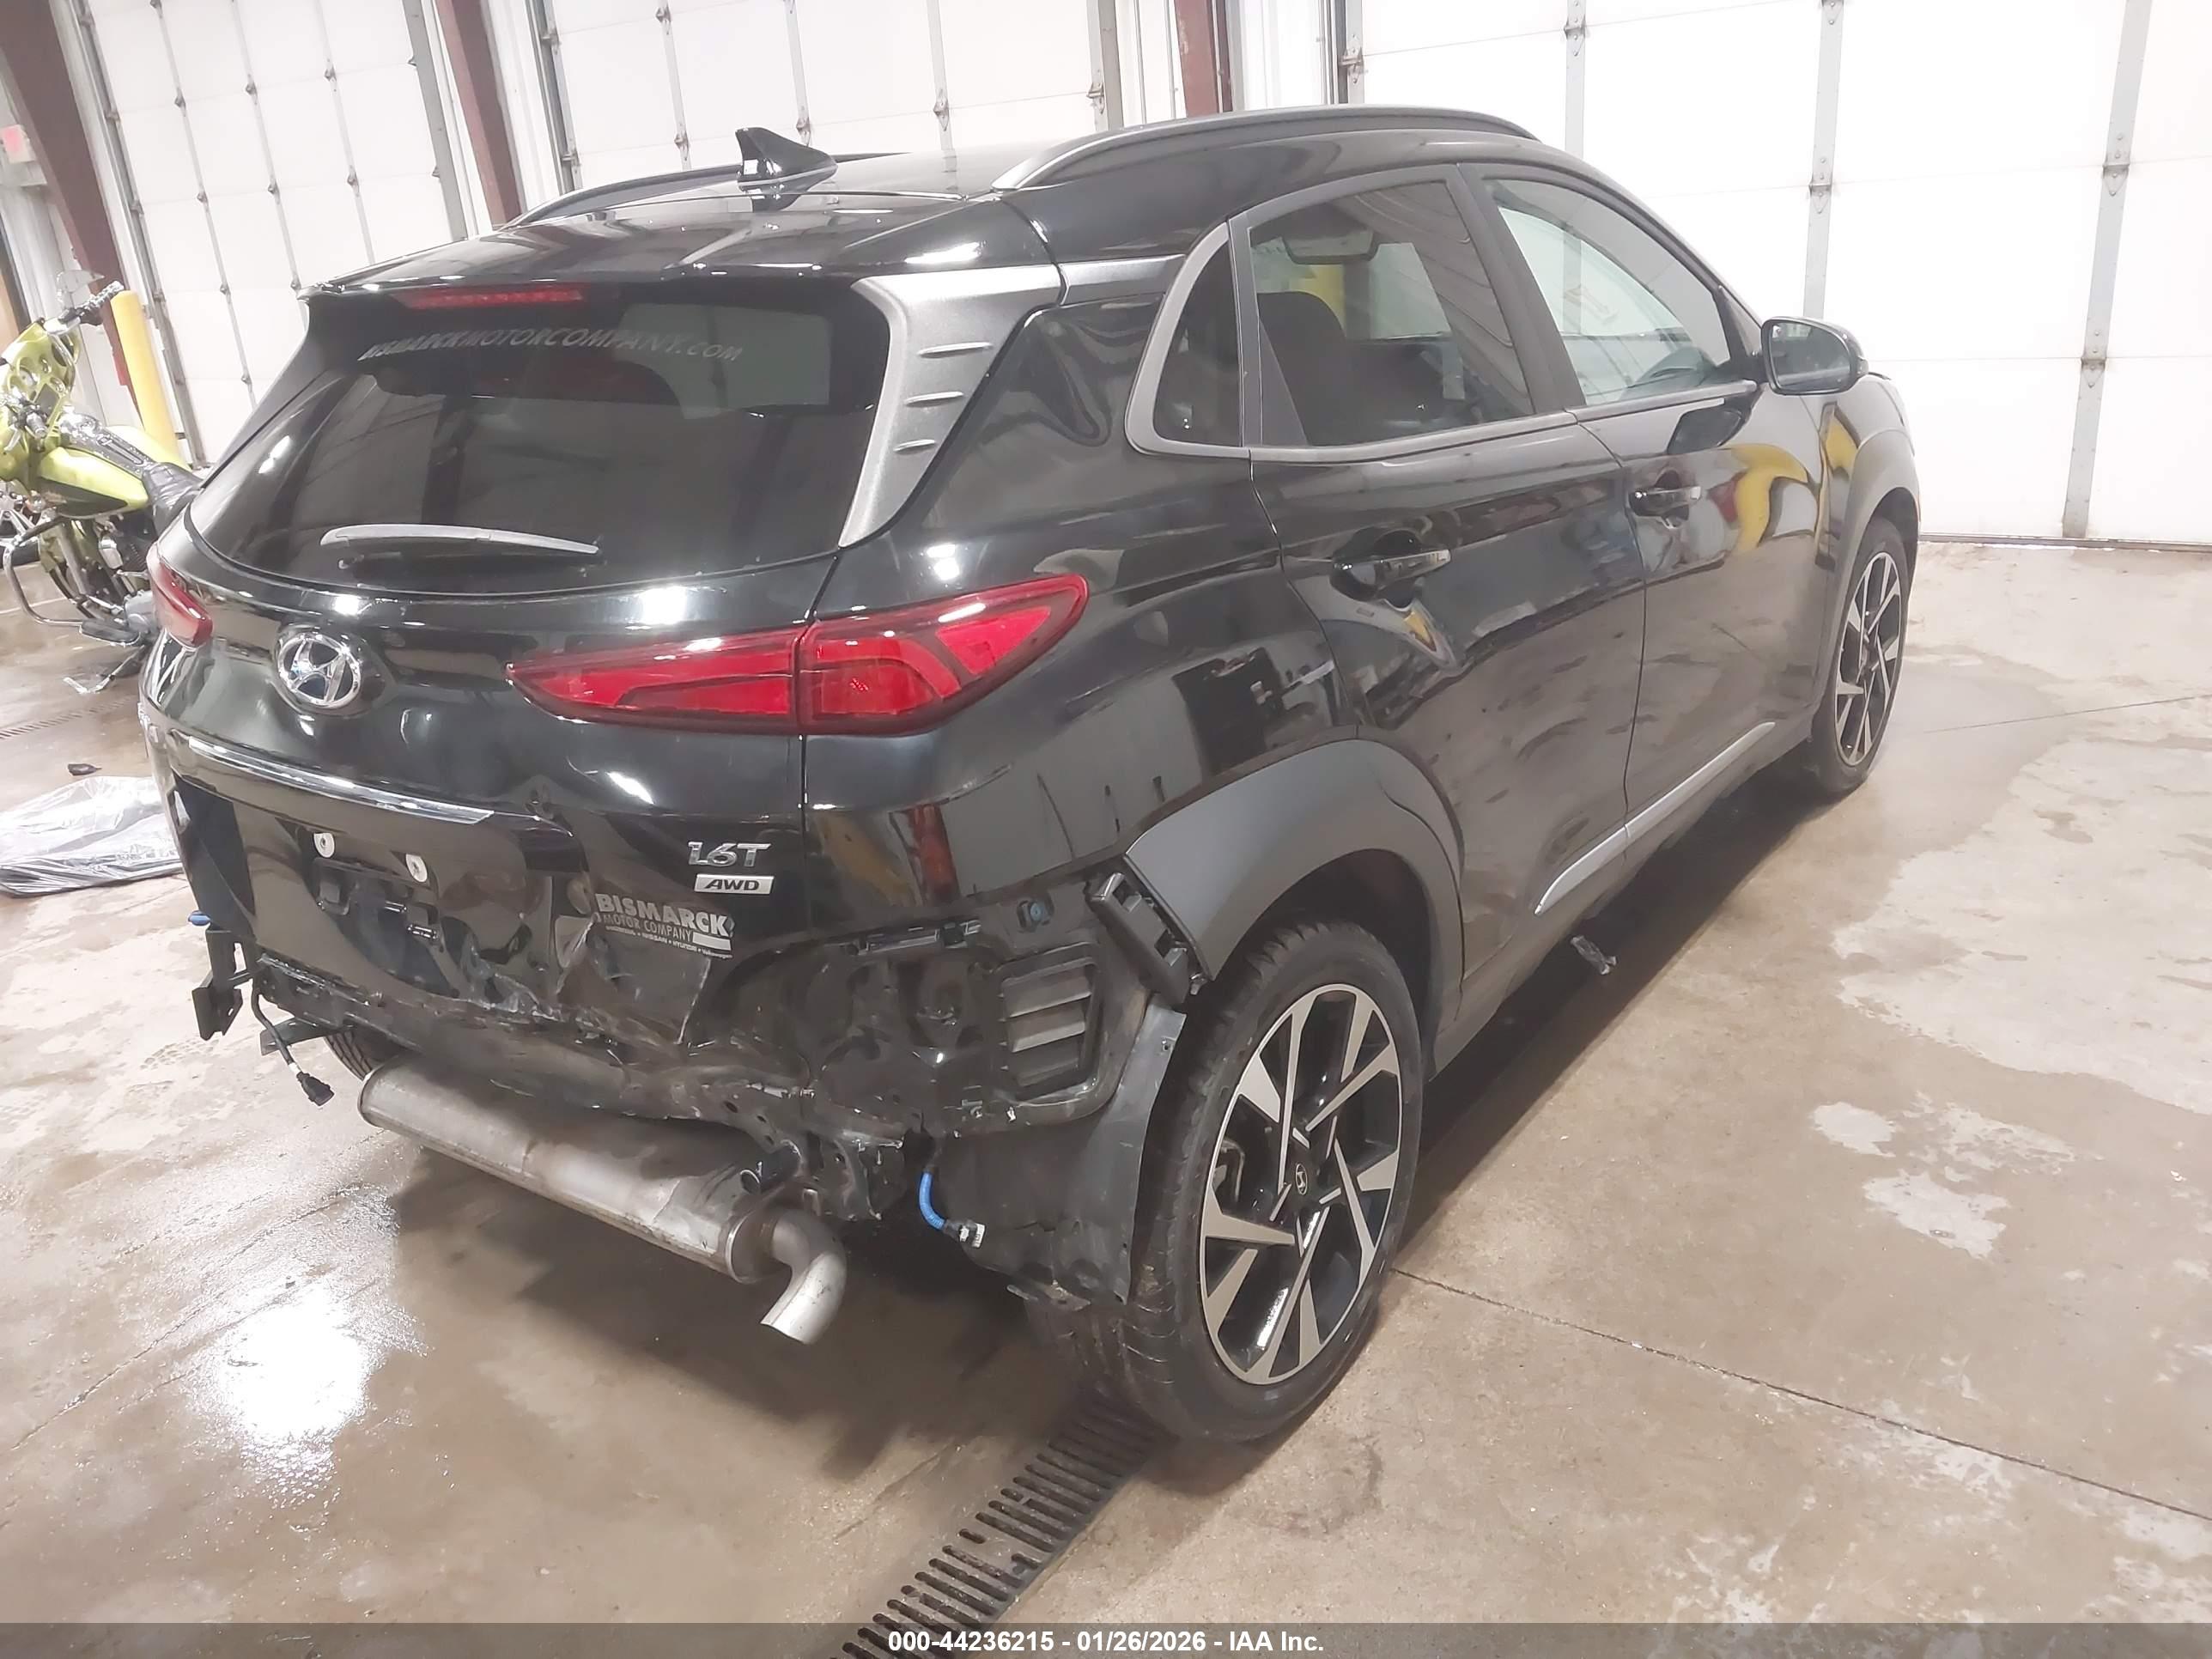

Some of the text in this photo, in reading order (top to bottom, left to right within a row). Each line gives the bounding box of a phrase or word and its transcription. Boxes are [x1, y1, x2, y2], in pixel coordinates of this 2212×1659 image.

[704, 878, 760, 890] AWD
[594, 893, 729, 937] BISMARCK
[602, 913, 641, 929] MOTOR
[644, 920, 693, 942] COMPANY
